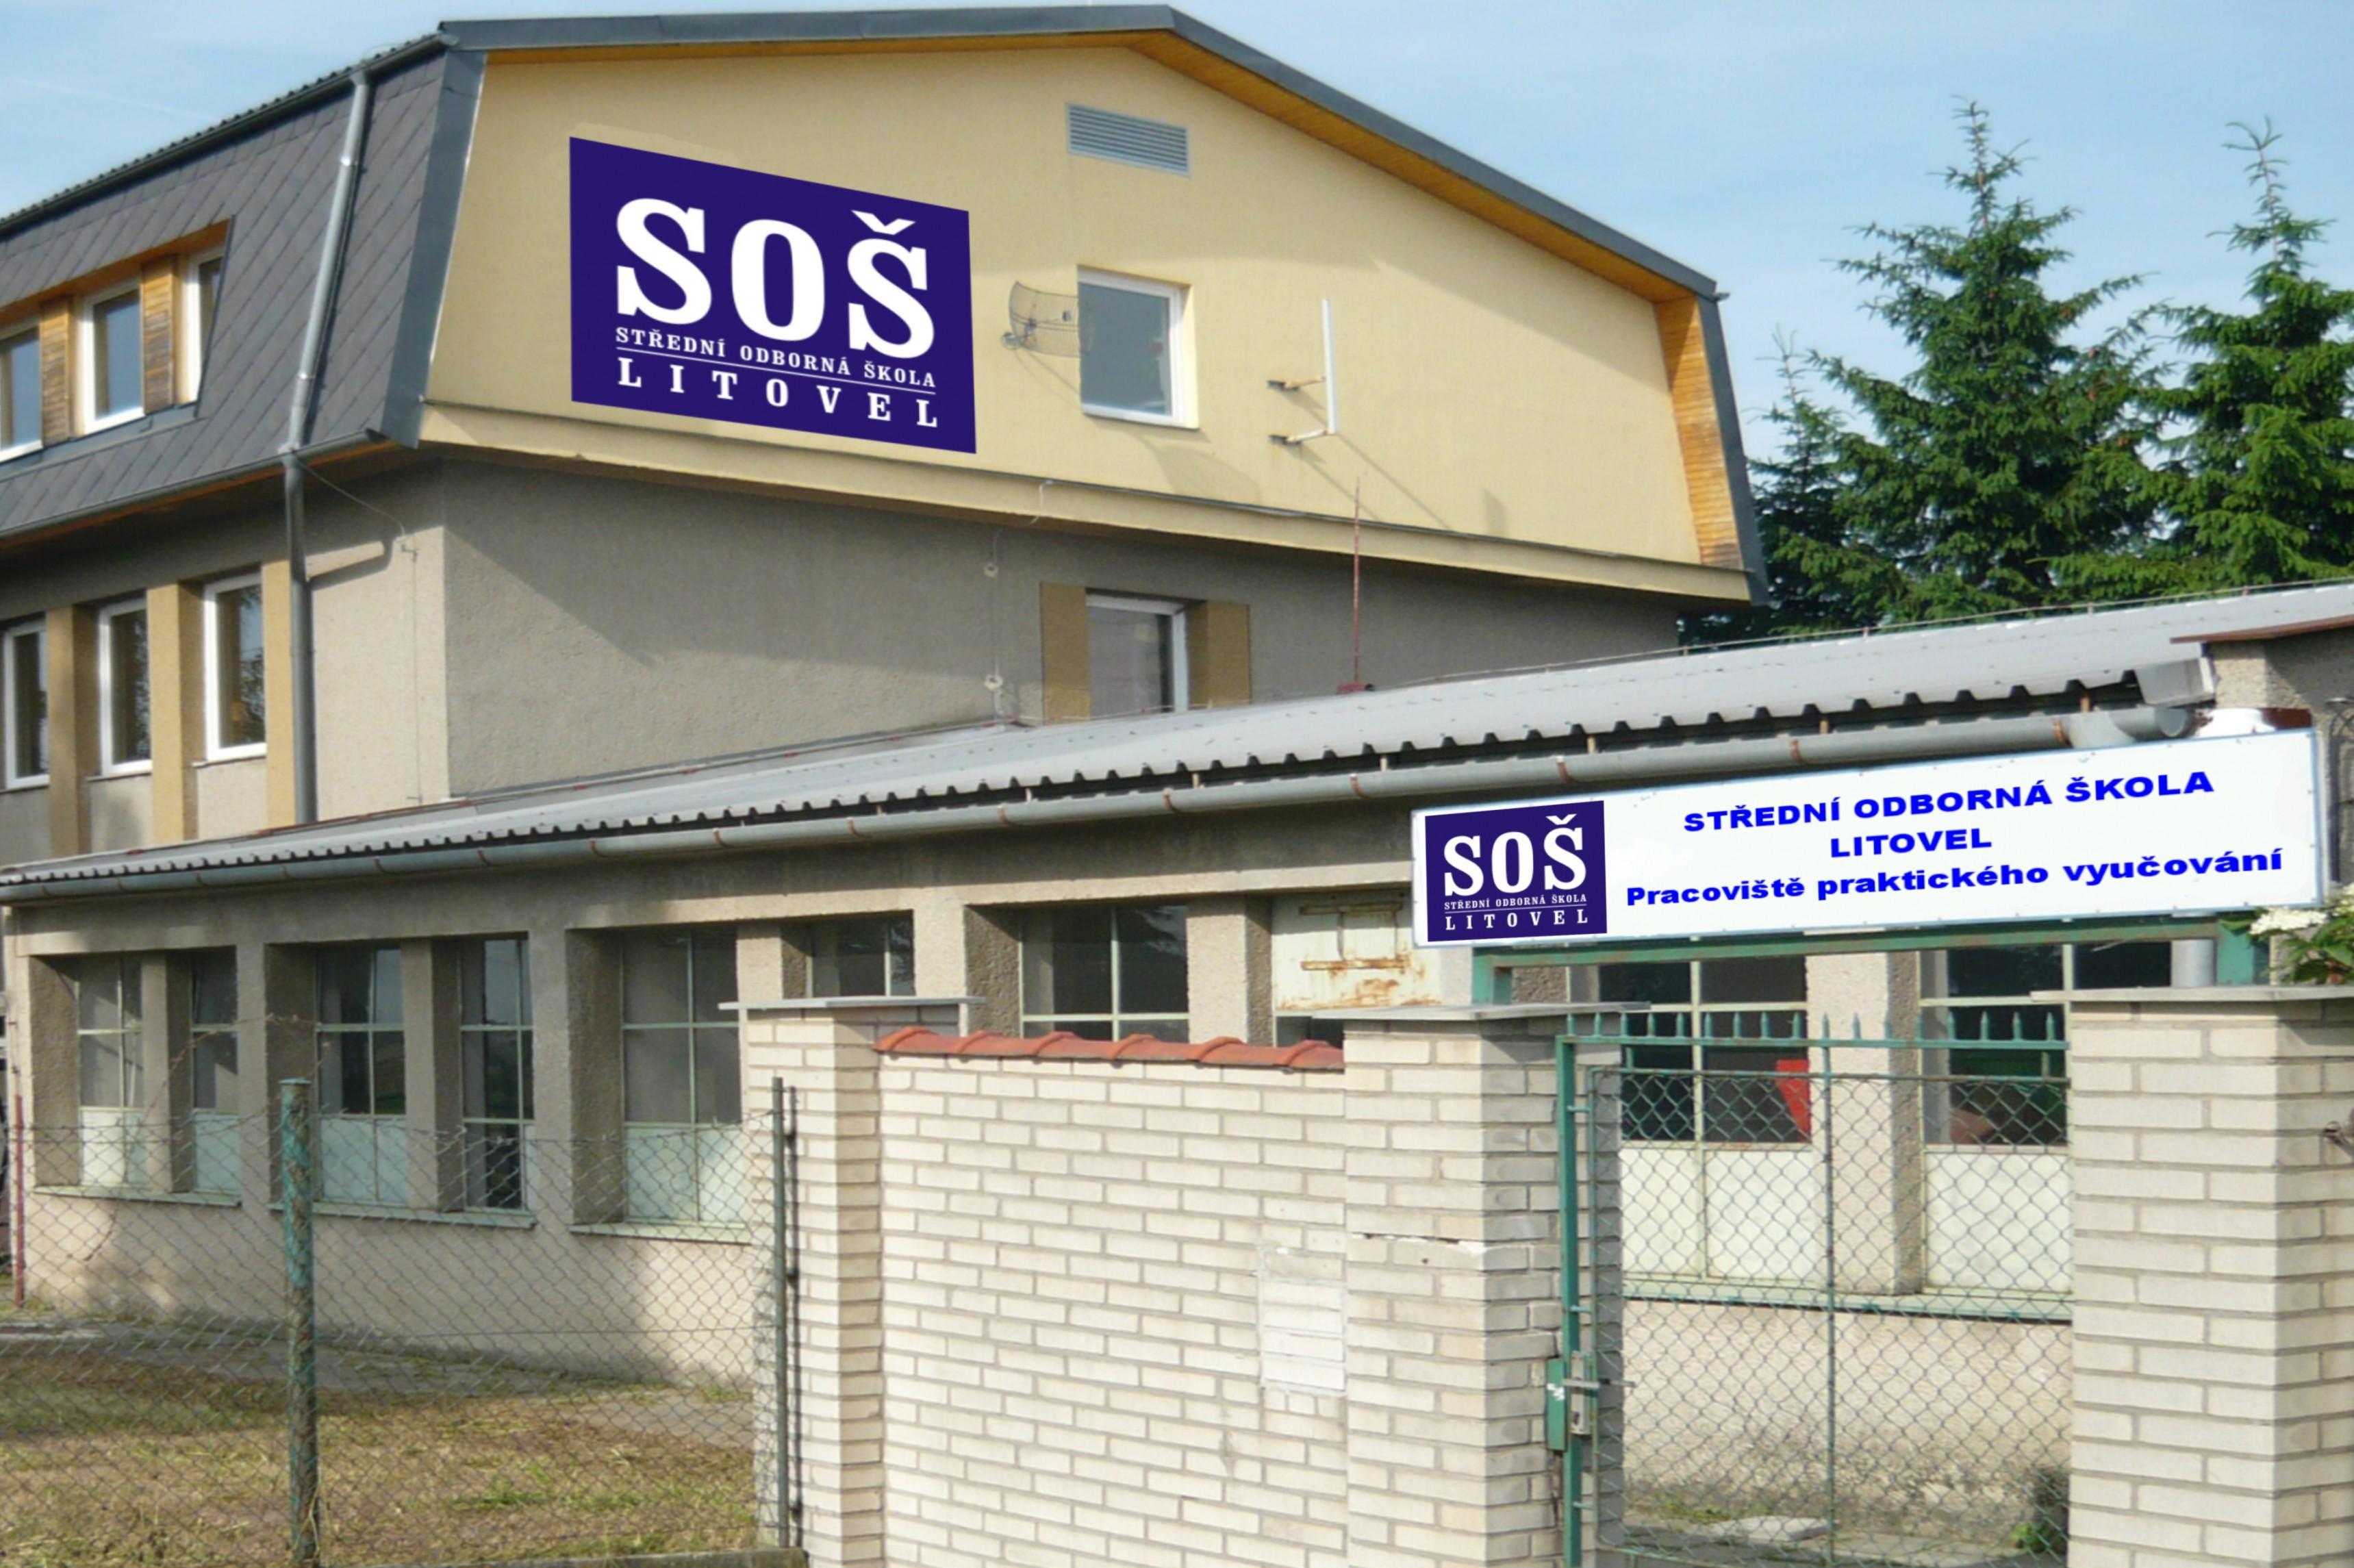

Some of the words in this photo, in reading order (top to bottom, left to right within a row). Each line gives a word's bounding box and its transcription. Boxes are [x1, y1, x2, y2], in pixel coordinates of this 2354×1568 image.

[616, 198, 934, 359] SOŠ
[616, 327, 726, 357] STŘEDNÍ
[740, 345, 851, 376] ODBORNÁ
[864, 360, 935, 388] ŠKOLA
[618, 357, 937, 428] LITOVEL
[1684, 796, 1840, 832] STŘEDNÍ
[1853, 780, 2053, 819] ODBORNÁ
[2065, 771, 2214, 802] ŠKOLA
[1443, 813, 1586, 896] SOŠ
[1830, 828, 1992, 858] LITOVEL
[1444, 898, 1490, 910] STŘEDNÍ
[1495, 894, 1545, 907] ODBORNÁ
[1552, 894, 1587, 904] ŠKOLA
[1627, 877, 1805, 907] Pracoviště
[1818, 864, 2049, 901] praktického
[2062, 848, 2283, 887] vyučování
[1445, 909, 1588, 931] LITOVEL
